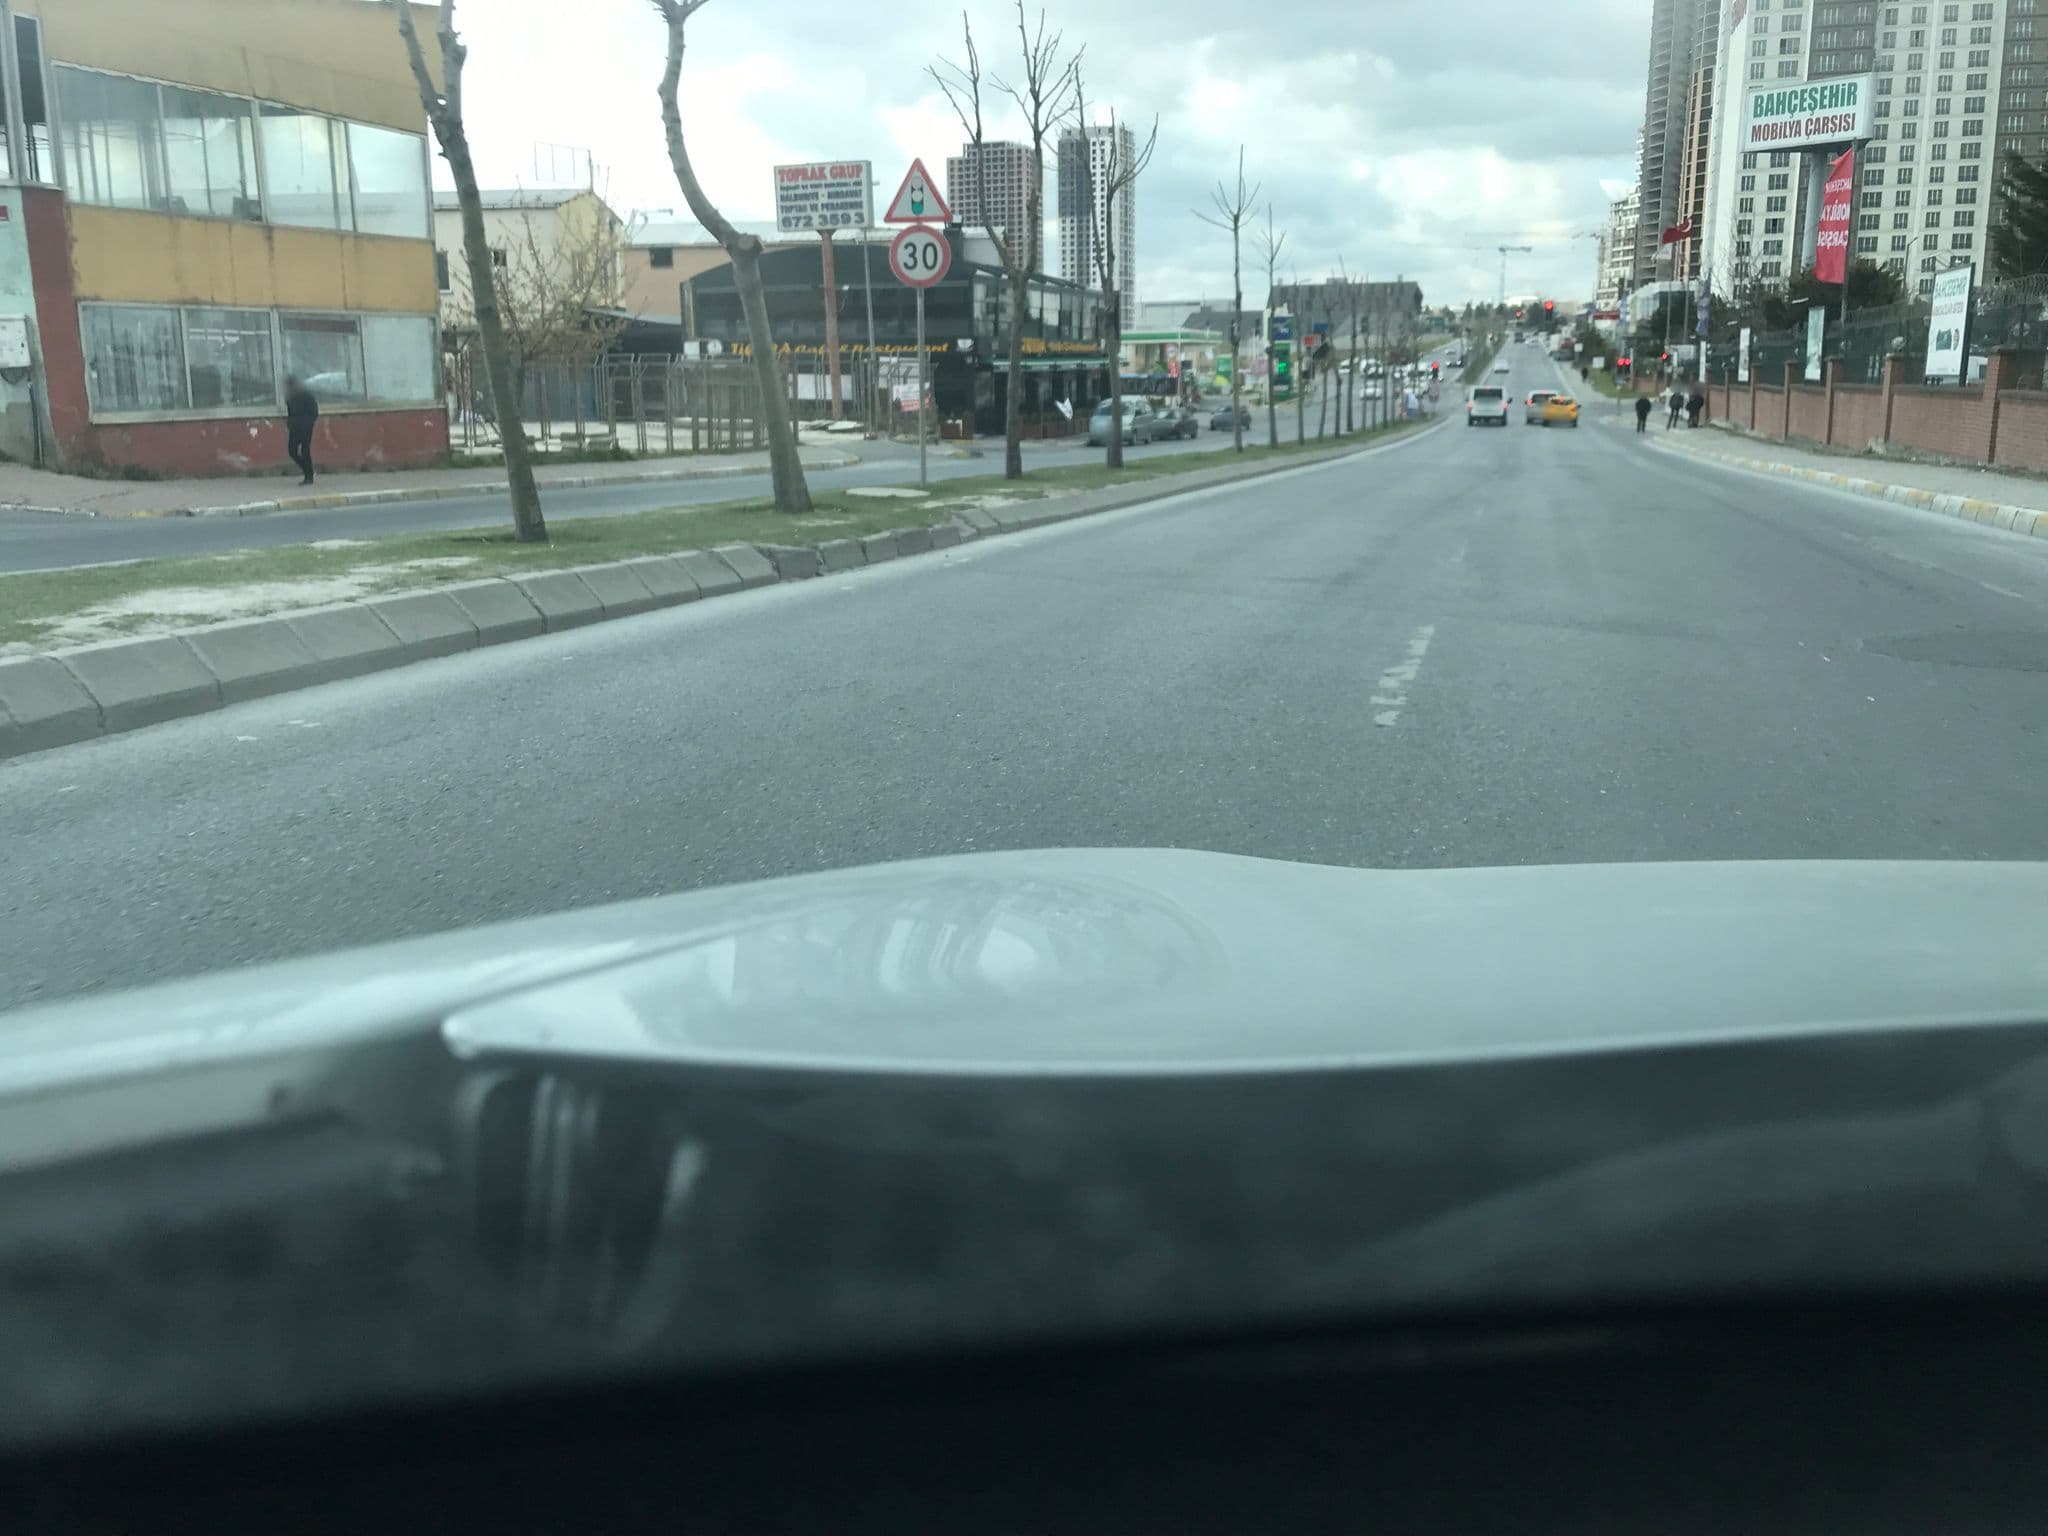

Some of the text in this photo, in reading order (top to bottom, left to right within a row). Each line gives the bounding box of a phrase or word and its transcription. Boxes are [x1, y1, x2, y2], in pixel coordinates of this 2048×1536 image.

[1753, 82, 1858, 118] BAHÇEŞEHİR
[1751, 113, 1856, 143] MOBİLYA ÇARŞISI
[778, 163, 863, 183] TOPRAK GRUP
[782, 215, 813, 228] 672
[904, 242, 938, 270] 30
